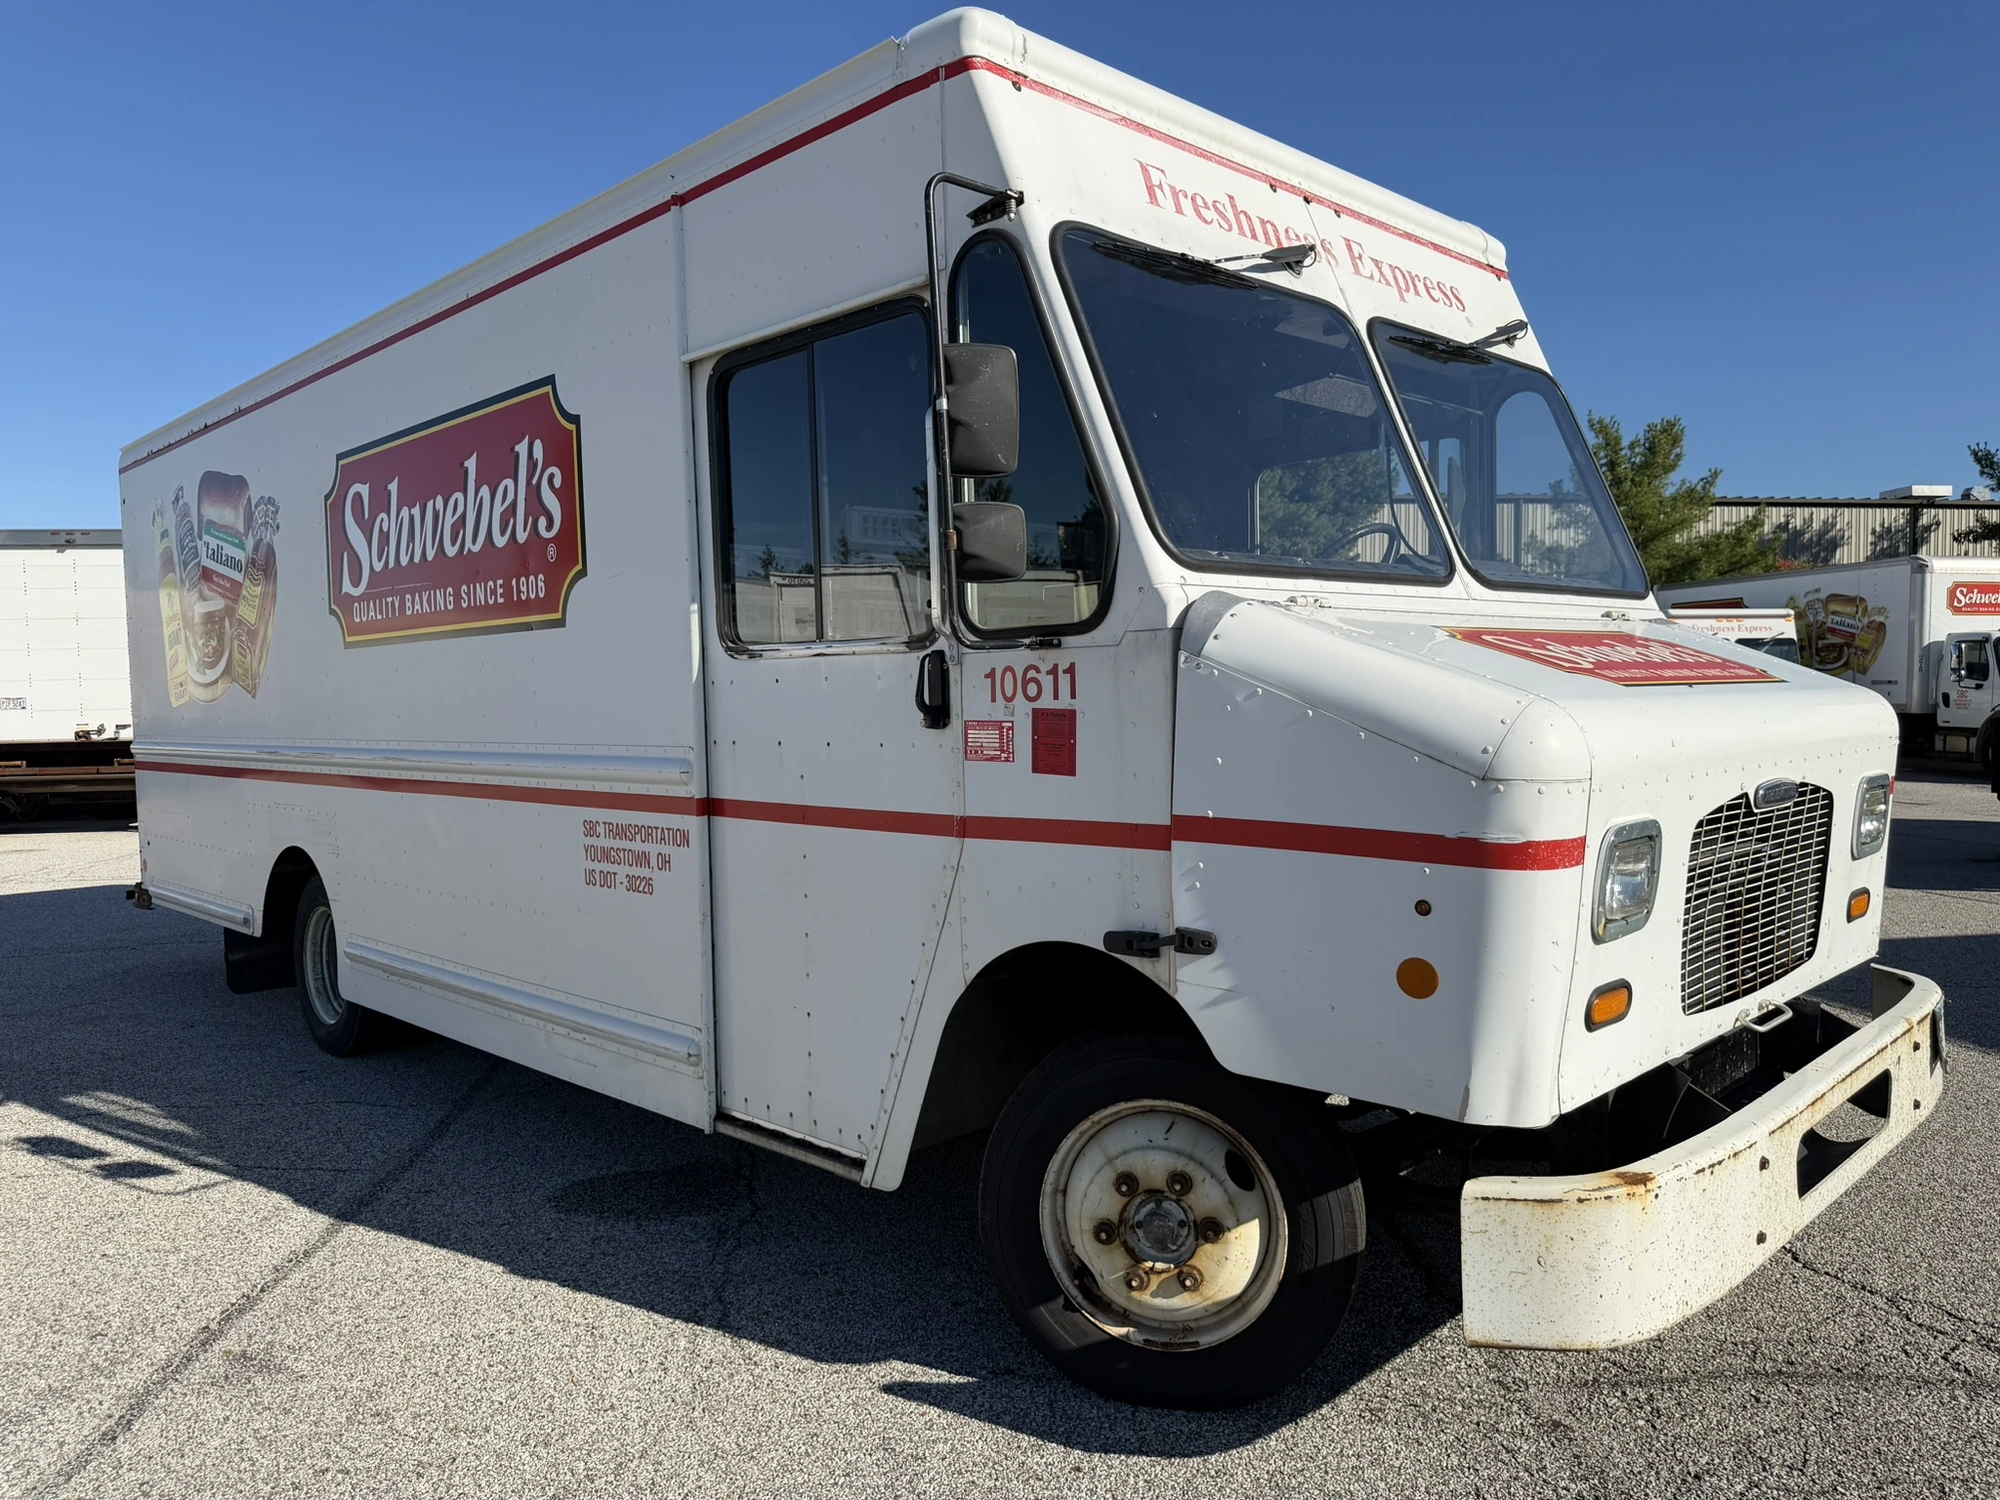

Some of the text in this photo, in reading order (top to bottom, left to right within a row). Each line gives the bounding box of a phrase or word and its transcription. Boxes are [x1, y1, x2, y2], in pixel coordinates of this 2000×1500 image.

[1339, 235, 1467, 312] Express
[342, 435, 562, 596] Schwebel's
[353, 573, 545, 622] QUALITY BAKING SINCE 1906
[1737, 624, 1772, 633] Express
[984, 662, 1077, 703] 10611
[1956, 689, 1968, 699] SBC
[583, 819, 690, 848] SBC TRANSPORTATION
[583, 844, 671, 873] YOUNGSTOWN, OH
[584, 868, 597, 887] US
[599, 870, 617, 889] DOT
[625, 874, 654, 895] 30226
